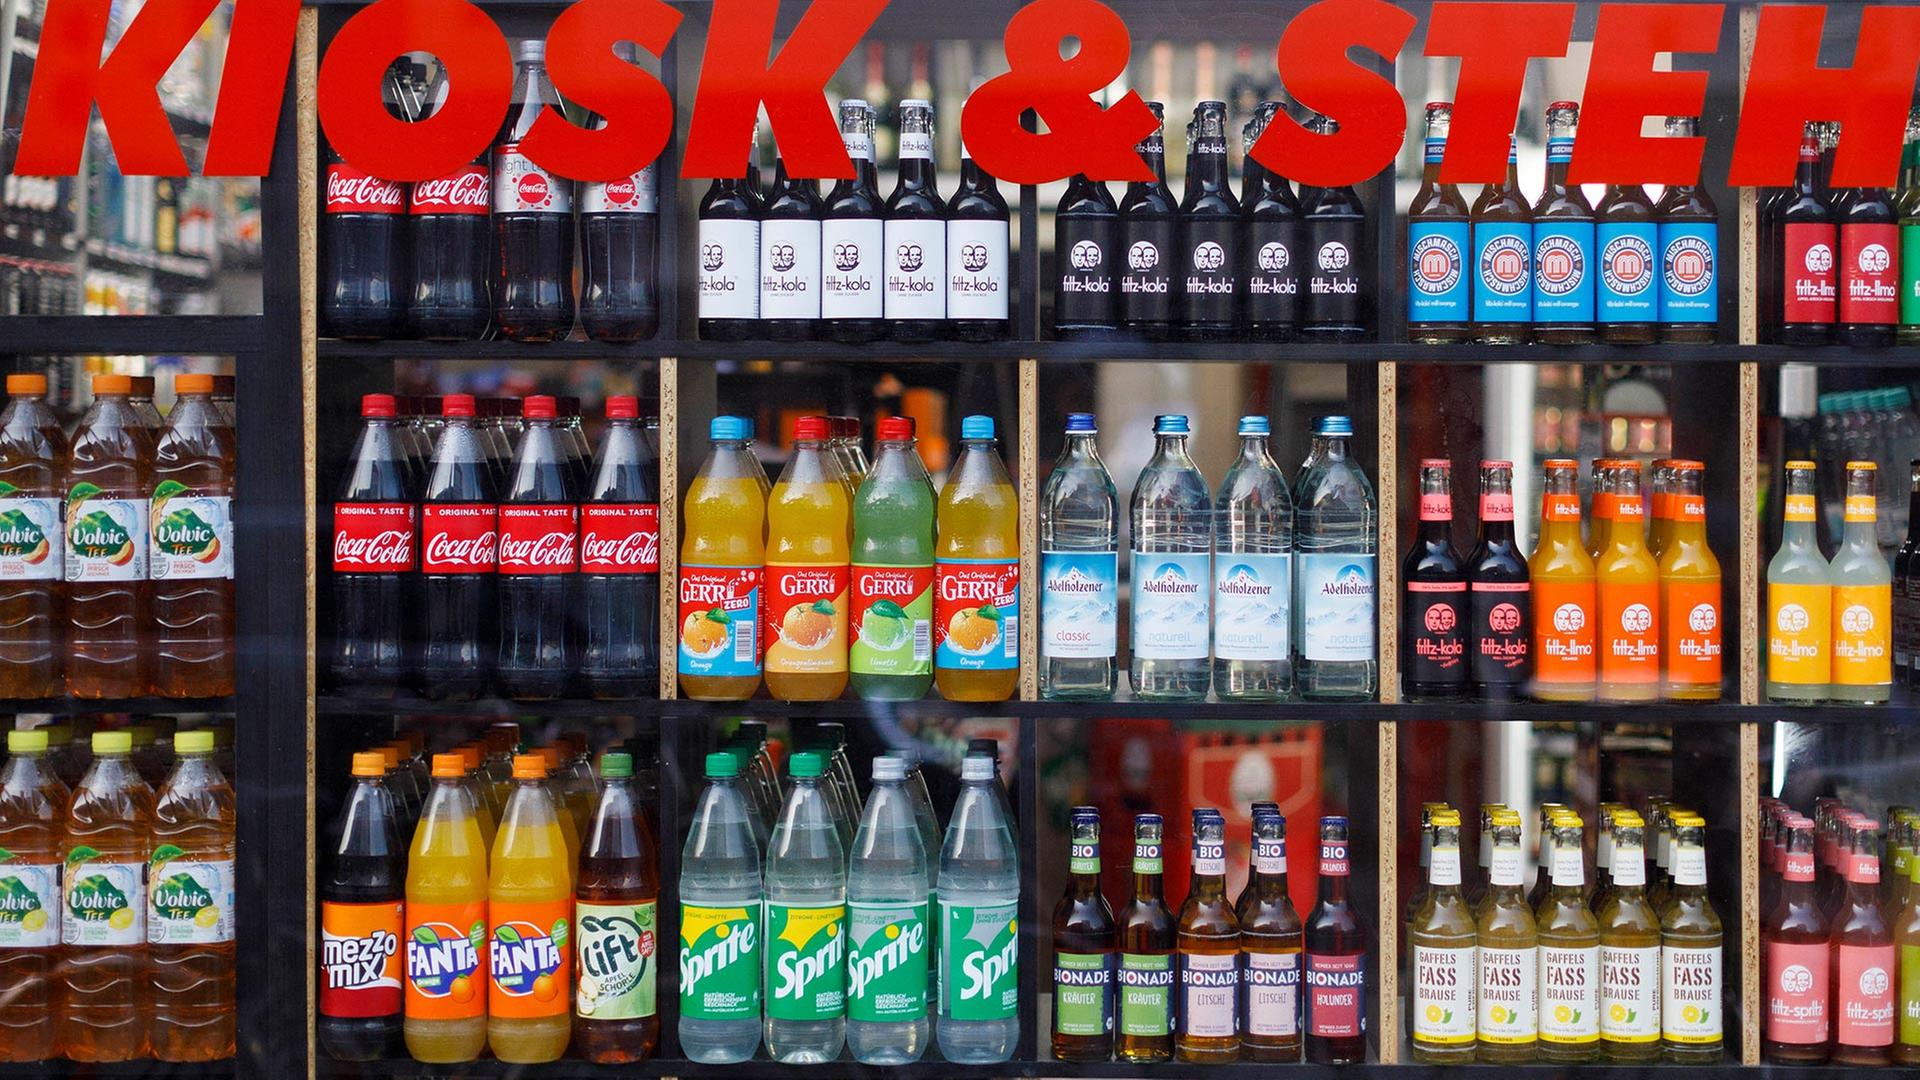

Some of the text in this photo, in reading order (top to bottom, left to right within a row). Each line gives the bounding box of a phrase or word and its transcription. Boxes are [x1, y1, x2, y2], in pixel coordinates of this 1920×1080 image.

[13, 0, 1920, 187] KIOSK & STEH
[327, 171, 401, 205] Coca-Cola
[413, 172, 489, 206] Coca-Cola
[519, 183, 547, 193] Coca-Cola
[607, 183, 635, 193] Coca-Cola
[1413, 236, 1459, 262] MISCHMASCH
[1483, 237, 1529, 262] MISCHMASCH
[1536, 237, 1582, 262] MISCHMASCH
[1604, 238, 1651, 262] MISCHMASCH
[1666, 238, 1712, 263] MISCHMASCH
[763, 276, 806, 292] fritz-kola
[826, 275, 870, 291] fritz-kola
[889, 276, 934, 292] fritz-kola
[952, 276, 998, 292] fritz-kola
[1063, 275, 1109, 292] fritz-kola
[1122, 276, 1167, 293] fritz-kola
[1187, 276, 1232, 293] fritz-kola
[1250, 277, 1296, 294] fritz-kola
[1311, 277, 1356, 294] fritz-kola
[1849, 279, 1896, 297] fritz-limo
[341, 507, 404, 515] ORIGINAL TASTE
[439, 508, 480, 516] ORIGINAL
[505, 509, 540, 517] ORIGINAL
[627, 508, 652, 516] TASTE
[0, 526, 39, 543] olvic
[73, 527, 125, 545] Volvic
[159, 525, 210, 543] Volvic
[3, 544, 22, 556] TEE
[86, 545, 107, 558] TEE
[172, 543, 193, 555] TEE
[335, 530, 413, 564] Coca-Cola
[499, 532, 576, 566] Coca-Cola
[582, 531, 659, 565] Coca-Cola
[680, 577, 735, 604] GERRI
[780, 573, 835, 596] GERRI
[860, 573, 914, 597] GERRI
[942, 575, 1004, 601] GERRI
[1047, 579, 1103, 593] Adelholzener
[1143, 580, 1199, 594] Adelholzener
[1218, 581, 1272, 595] Adelholzener
[724, 598, 749, 610] ZERO
[994, 594, 1015, 606] ZERO
[1056, 630, 1092, 642] classic
[1148, 631, 1191, 642] naturell
[1416, 638, 1463, 655] fritz-kola
[1480, 638, 1526, 655] fritz-kola
[1545, 639, 1592, 656] fritz-limo
[1612, 639, 1657, 656] fritz-limo
[1771, 638, 1818, 656] fritz-limo
[1835, 639, 1884, 657] fritz-limo
[960, 657, 985, 669] Orange
[1072, 845, 1094, 857] BIO
[1136, 845, 1158, 857] BIO
[1200, 846, 1222, 858] BIO
[1259, 845, 1281, 857] BIO
[1322, 846, 1345, 858] BIO
[70, 891, 122, 908] Volvic
[155, 889, 207, 907] Volvic
[83, 910, 105, 921] TEE
[168, 908, 191, 920] TEE
[323, 930, 397, 965] mezzo
[407, 938, 479, 977] FANTA
[489, 937, 561, 976] FANTA
[680, 922, 756, 997] Sprite
[848, 922, 923, 1000] Sprite
[1419, 951, 1456, 965] GAFFELS
[1483, 952, 1521, 966] GAFFELS
[1546, 952, 1585, 965] GAFFELS
[1603, 951, 1640, 964] GAFFELS
[1673, 952, 1712, 965] GAFFELS
[328, 952, 381, 988] mix
[604, 972, 626, 984] APFEL
[1054, 968, 1109, 984] BIONADE
[1118, 969, 1174, 985] BIONADE
[1182, 970, 1239, 985] BIONADE
[1244, 969, 1300, 985] BIONADE
[1307, 970, 1363, 986] BIONADE
[1419, 965, 1456, 987] FASS
[1483, 966, 1521, 987] FASS
[1546, 966, 1585, 986] FASS
[1603, 965, 1640, 986] FASS
[1673, 966, 1712, 986] FASS
[600, 972, 636, 992] SCHORLE
[1063, 991, 1096, 1004] KRÄUTER
[1128, 992, 1161, 1005] KRÄUTER
[1197, 993, 1225, 1006] LITSCHI
[1258, 992, 1287, 1005] LITSCHI
[1316, 993, 1353, 1006] HOLUNDER
[1419, 987, 1456, 1001] BRAUSE
[1483, 987, 1521, 1001] BRAUSE
[1546, 988, 1585, 1001] BRAUSE
[1603, 988, 1640, 1001] BRAUSE
[1673, 988, 1712, 1001] BRAUSE
